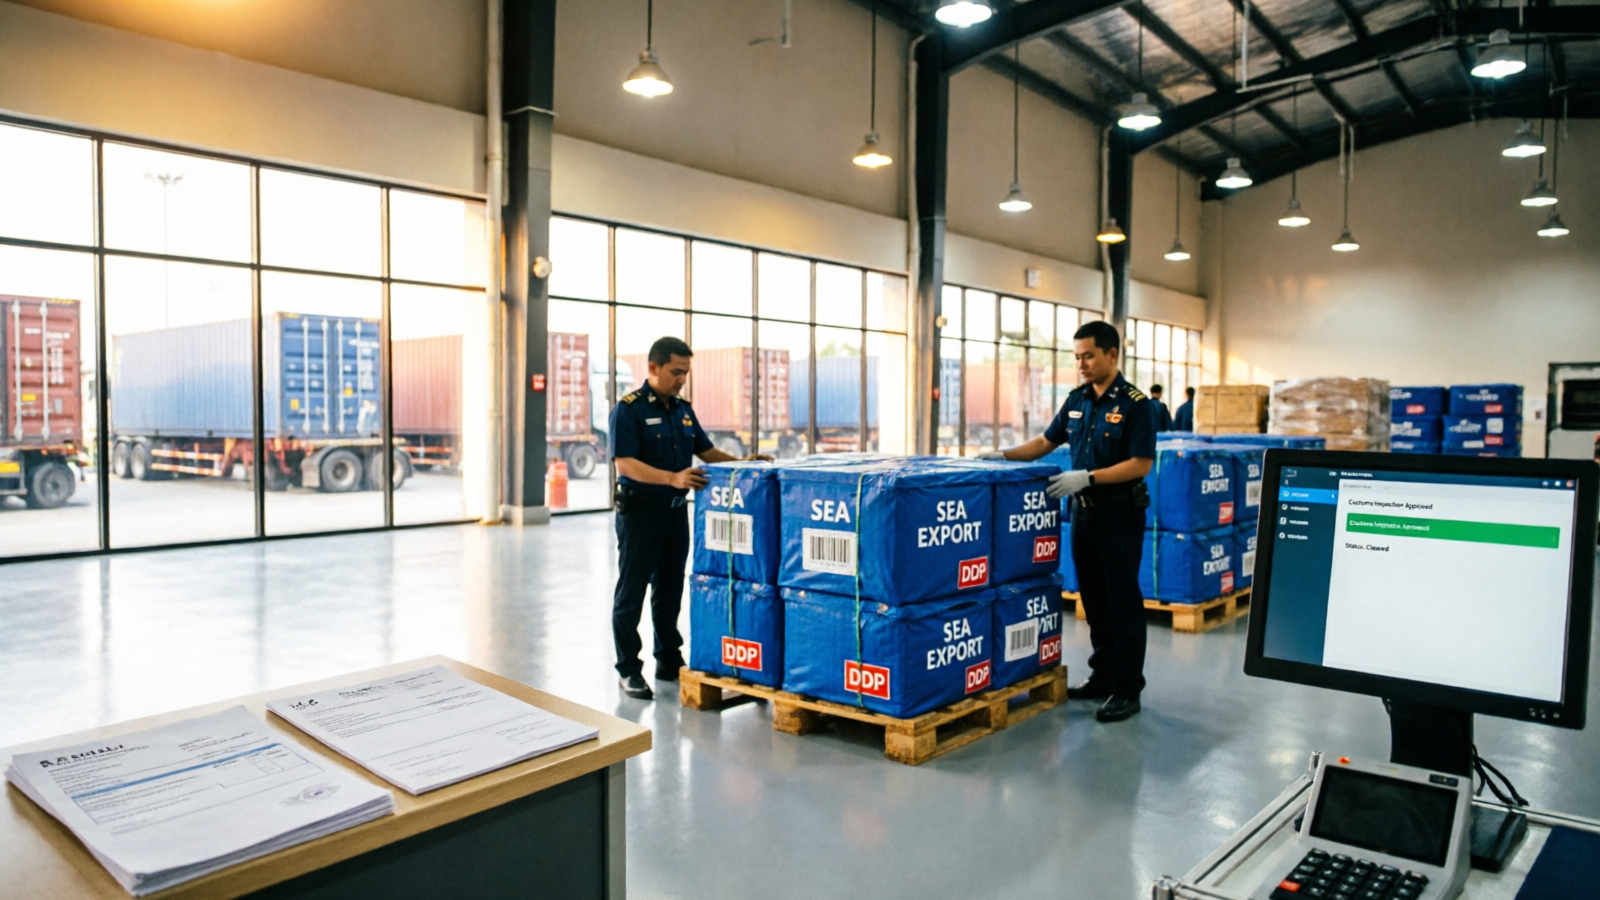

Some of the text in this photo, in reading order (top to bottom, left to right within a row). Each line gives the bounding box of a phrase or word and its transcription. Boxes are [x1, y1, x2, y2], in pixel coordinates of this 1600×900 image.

[710, 486, 745, 508] SEA
[1024, 492, 1047, 511] SEA
[811, 499, 851, 524] SEA
[937, 500, 968, 522] SEA
[1010, 511, 1057, 533] EXPORT
[918, 522, 982, 548] EXPORT
[1037, 542, 1056, 557] DDP
[961, 563, 987, 583] DDP
[1026, 596, 1049, 618] SEA
[944, 618, 972, 642] SEA
[725, 643, 758, 663] DDP
[927, 636, 985, 670] EXPORT
[848, 668, 885, 690] DDP
[968, 667, 989, 688] DDP
